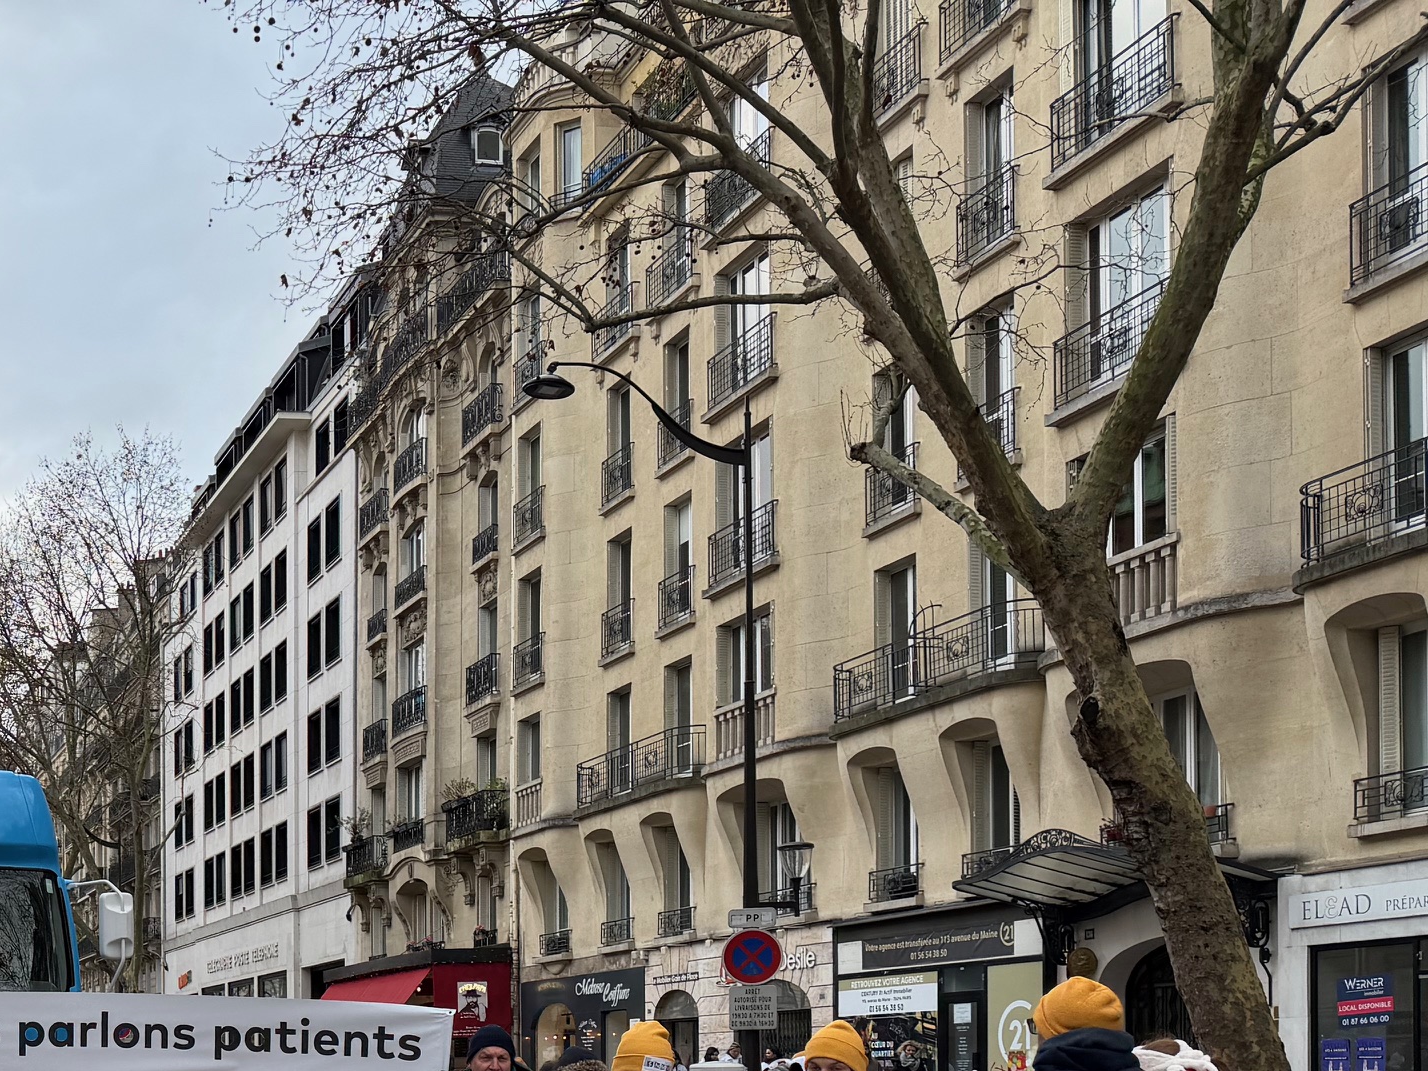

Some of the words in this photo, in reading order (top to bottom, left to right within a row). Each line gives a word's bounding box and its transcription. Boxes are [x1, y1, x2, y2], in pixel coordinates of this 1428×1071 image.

[746, 914, 760, 922] PP
[1003, 925, 1014, 940] 21
[865, 943, 878, 952] Votre
[878, 943, 897, 953] agence
[897, 941, 905, 949] est
[951, 933, 971, 943] avenue
[972, 930, 979, 940] du
[980, 929, 999, 939] Maine
[917, 951, 925, 960] 56
[925, 951, 932, 959] 54
[850, 979, 882, 989] RETROUVEZ
[882, 977, 900, 987] VOTRE
[900, 975, 924, 985] AGENCE
[1344, 977, 1384, 990] WERNER
[602, 983, 631, 1007] Coiffure
[1338, 1004, 1358, 1012] LOCAL
[1358, 1001, 1392, 1010] DISPONIBLE
[1342, 1018, 1350, 1026] 01
[1350, 1017, 1358, 1026] 87
[1360, 1017, 1368, 1025] 66
[1369, 1016, 1379, 1024] 06
[1379, 1015, 1390, 1023] 00
[18, 1011, 196, 1057] parlons
[214, 1017, 422, 1061] patients
[1009, 1019, 1031, 1050] 21
[886, 1040, 894, 1049] DU
